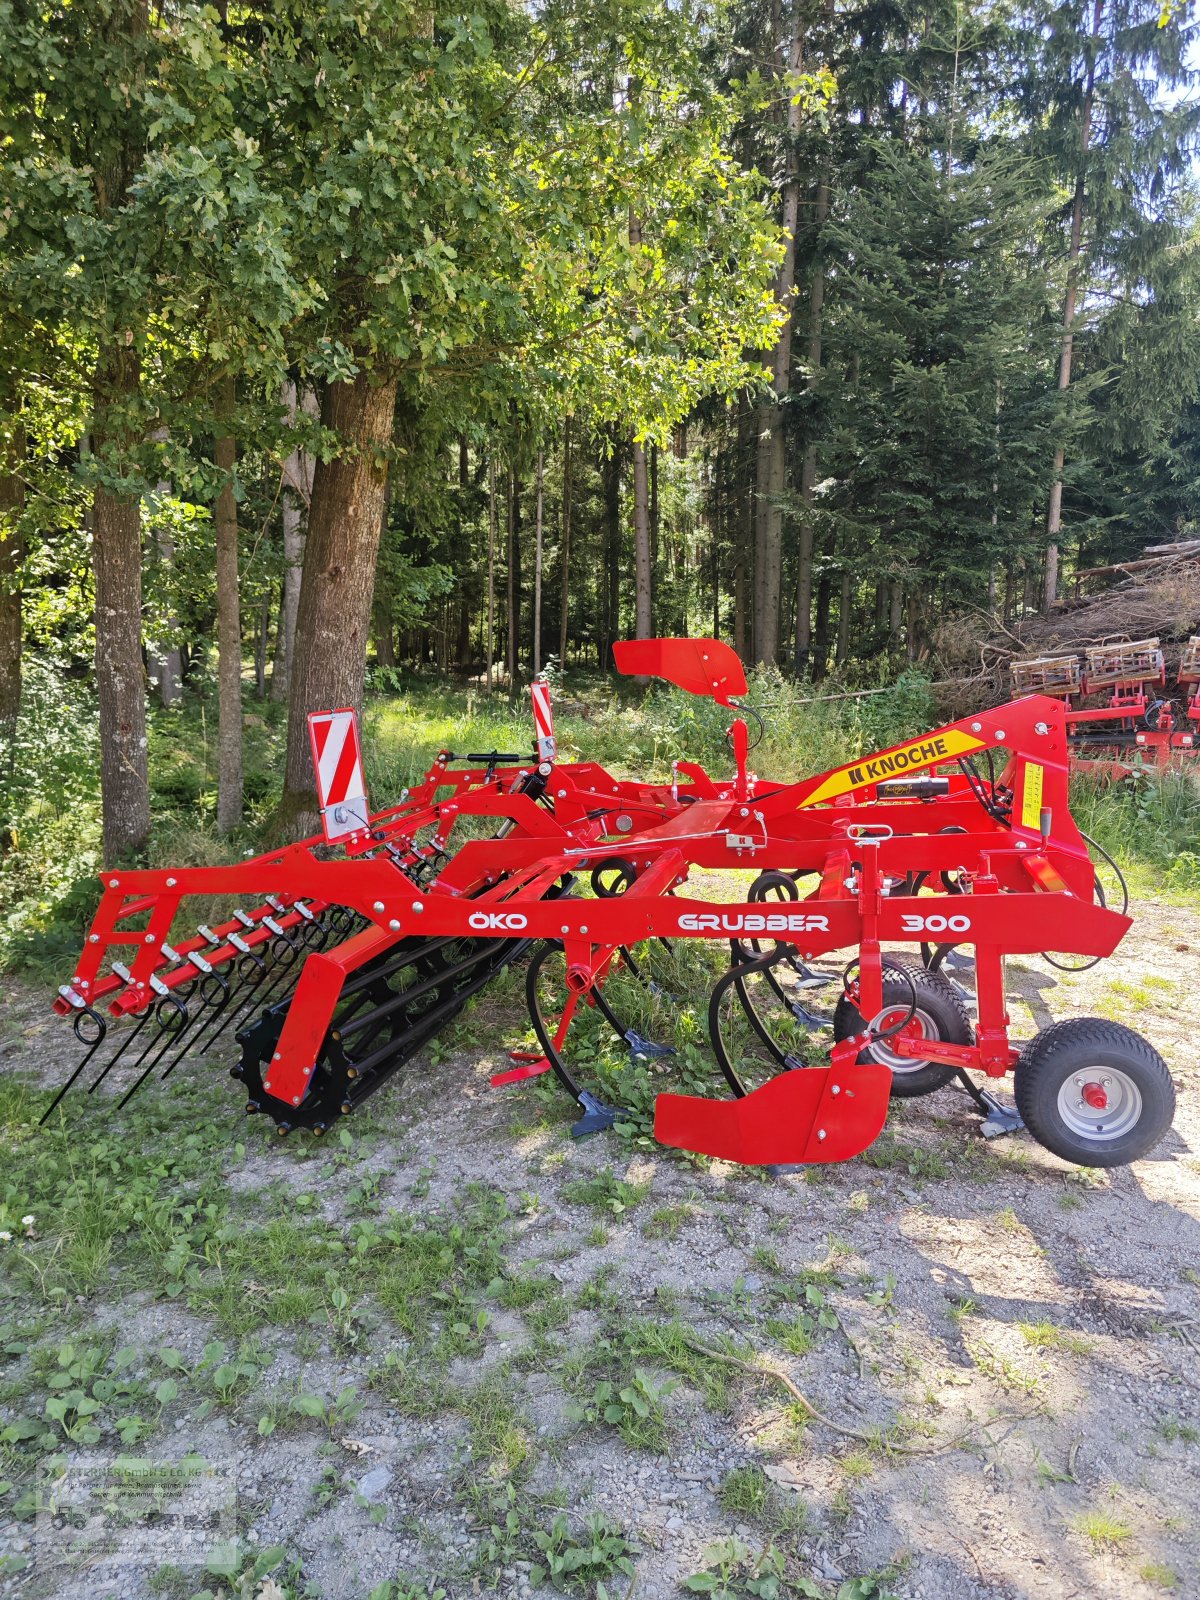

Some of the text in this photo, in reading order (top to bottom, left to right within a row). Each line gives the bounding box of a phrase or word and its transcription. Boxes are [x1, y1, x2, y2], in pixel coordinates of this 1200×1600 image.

[866, 738, 949, 779] KNOCHE
[468, 911, 971, 932] ÖKO GRUBBER 300
